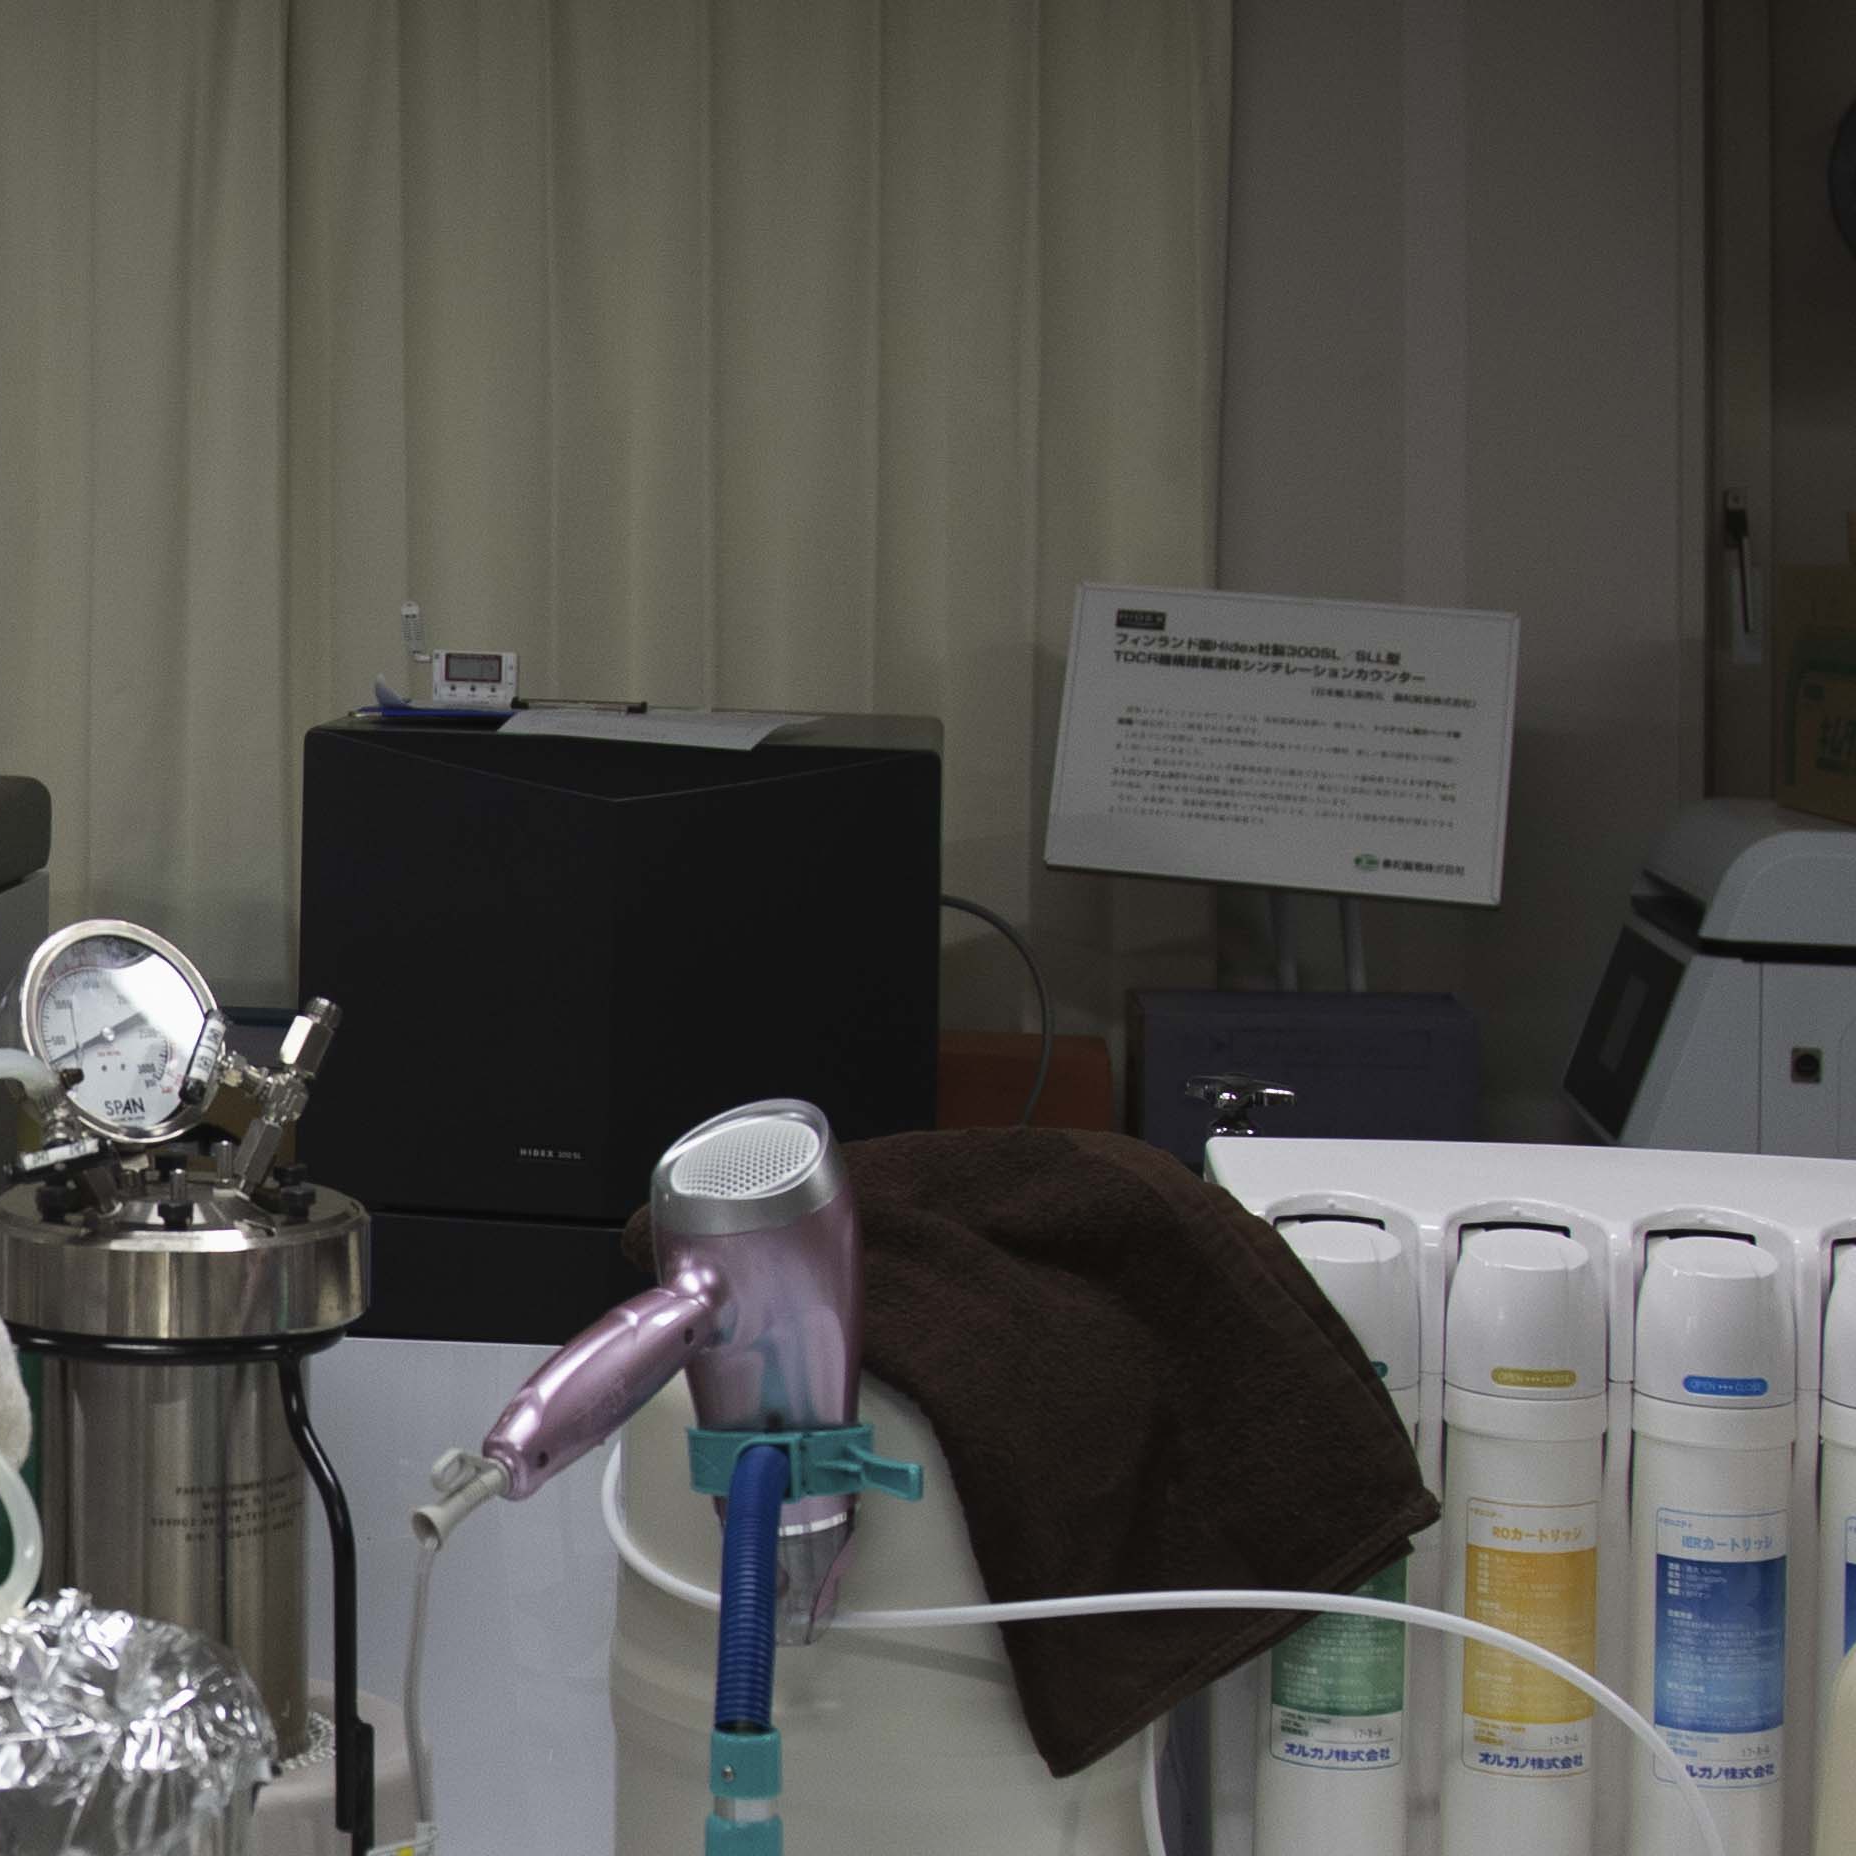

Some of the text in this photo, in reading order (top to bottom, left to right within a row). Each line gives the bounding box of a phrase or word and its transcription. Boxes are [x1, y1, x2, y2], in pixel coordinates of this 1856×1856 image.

[104, 1097, 145, 1116] SPAN
[520, 1148, 554, 1158] HIDEX
[1492, 1524, 1586, 1543] ROカートリッジ
[1284, 1742, 1391, 1761] オルガノ株式会社
[1478, 1752, 1583, 1770] オルガノ株式会社
[1685, 1762, 1775, 1780] ルガノ株式会社
